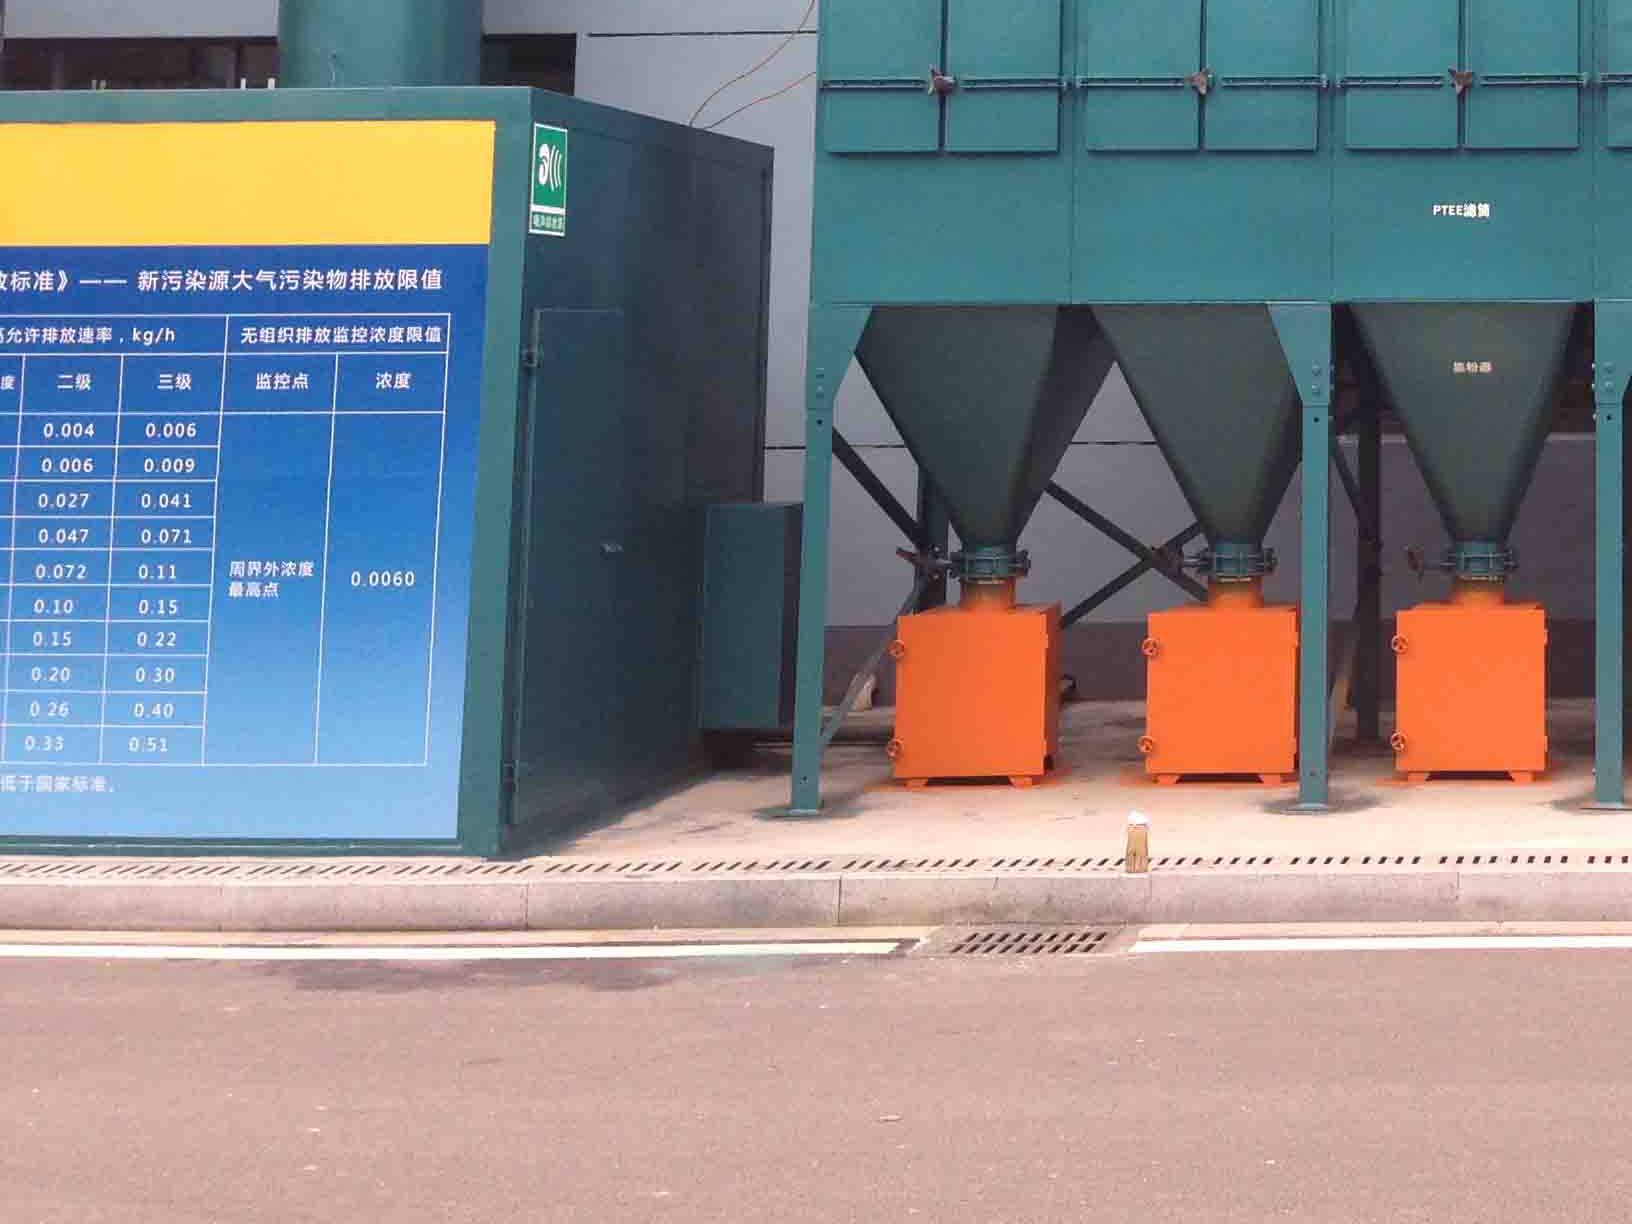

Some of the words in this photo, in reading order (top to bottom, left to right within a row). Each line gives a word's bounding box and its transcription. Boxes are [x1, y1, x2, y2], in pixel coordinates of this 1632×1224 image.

[137, 269, 443, 292] 新污染源大气污染物排放限值
[240, 326, 442, 344] 无组织排放监控浓度限值
[57, 373, 92, 391] 二级
[157, 373, 192, 391] 三级
[255, 372, 309, 391] 监控点
[375, 372, 412, 390] 浓度
[43, 423, 95, 438] 0.004
[145, 423, 197, 438] 0.006
[41, 458, 94, 473] 0.006
[143, 458, 195, 473] 0.009
[37, 493, 90, 509] 0.027
[140, 493, 193, 509] 0.041
[38, 528, 89, 544] 0.047
[140, 528, 193, 544] 0.071
[35, 564, 87, 579] 0.072
[138, 564, 177, 580] 0.11
[229, 560, 314, 577] 周界外浓度
[351, 571, 415, 587] 0.0060
[228, 581, 279, 598] 最高点
[33, 599, 73, 614] 0.10
[138, 599, 178, 615] 0.15
[32, 631, 72, 647] 0.15
[31, 666, 71, 682] 0.20
[135, 667, 175, 683] 0.30
[134, 702, 175, 718] 0.40
[128, 736, 168, 753] 0.51
